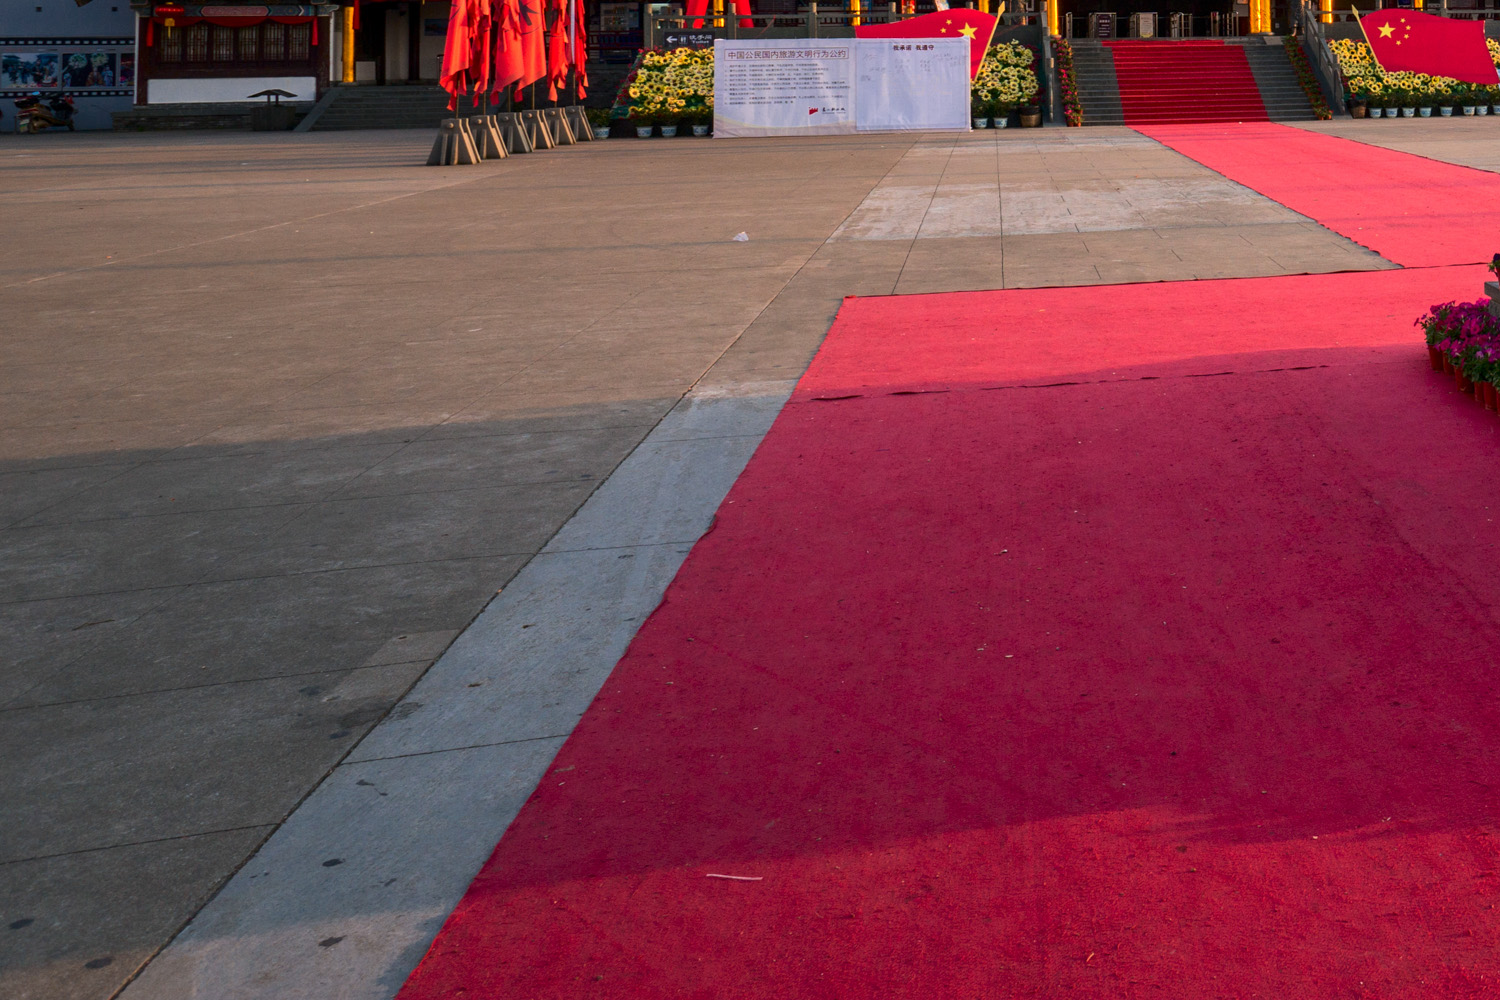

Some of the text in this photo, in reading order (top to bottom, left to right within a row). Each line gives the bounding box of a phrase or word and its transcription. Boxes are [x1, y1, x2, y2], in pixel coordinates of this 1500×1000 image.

[727, 49, 847, 60] 中国公民国内旅游文明行为公约
